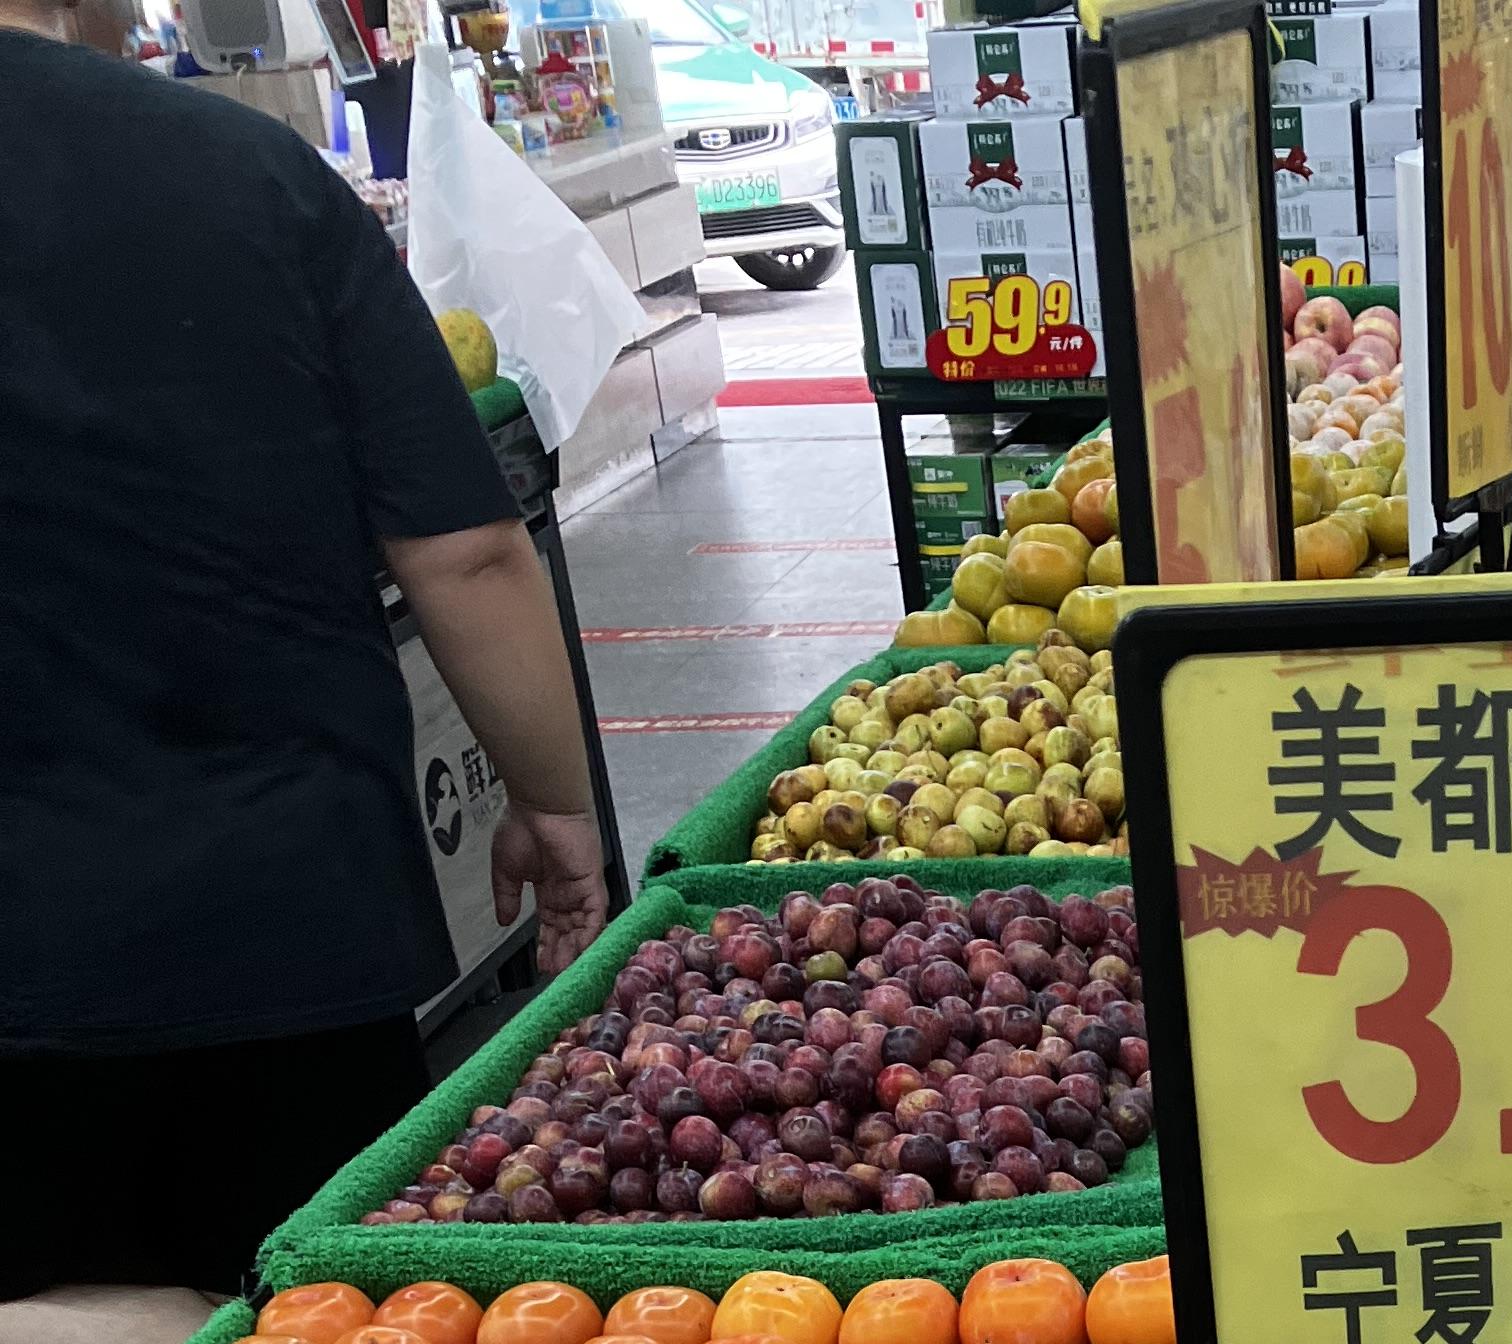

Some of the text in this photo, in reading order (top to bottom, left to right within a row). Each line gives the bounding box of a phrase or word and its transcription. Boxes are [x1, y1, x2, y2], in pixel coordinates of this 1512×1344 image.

[946, 275, 1073, 358] 59.9
[942, 360, 976, 378] 特价
[1031, 380, 1069, 397] FIFA
[1197, 871, 1318, 921] 惊爆价
